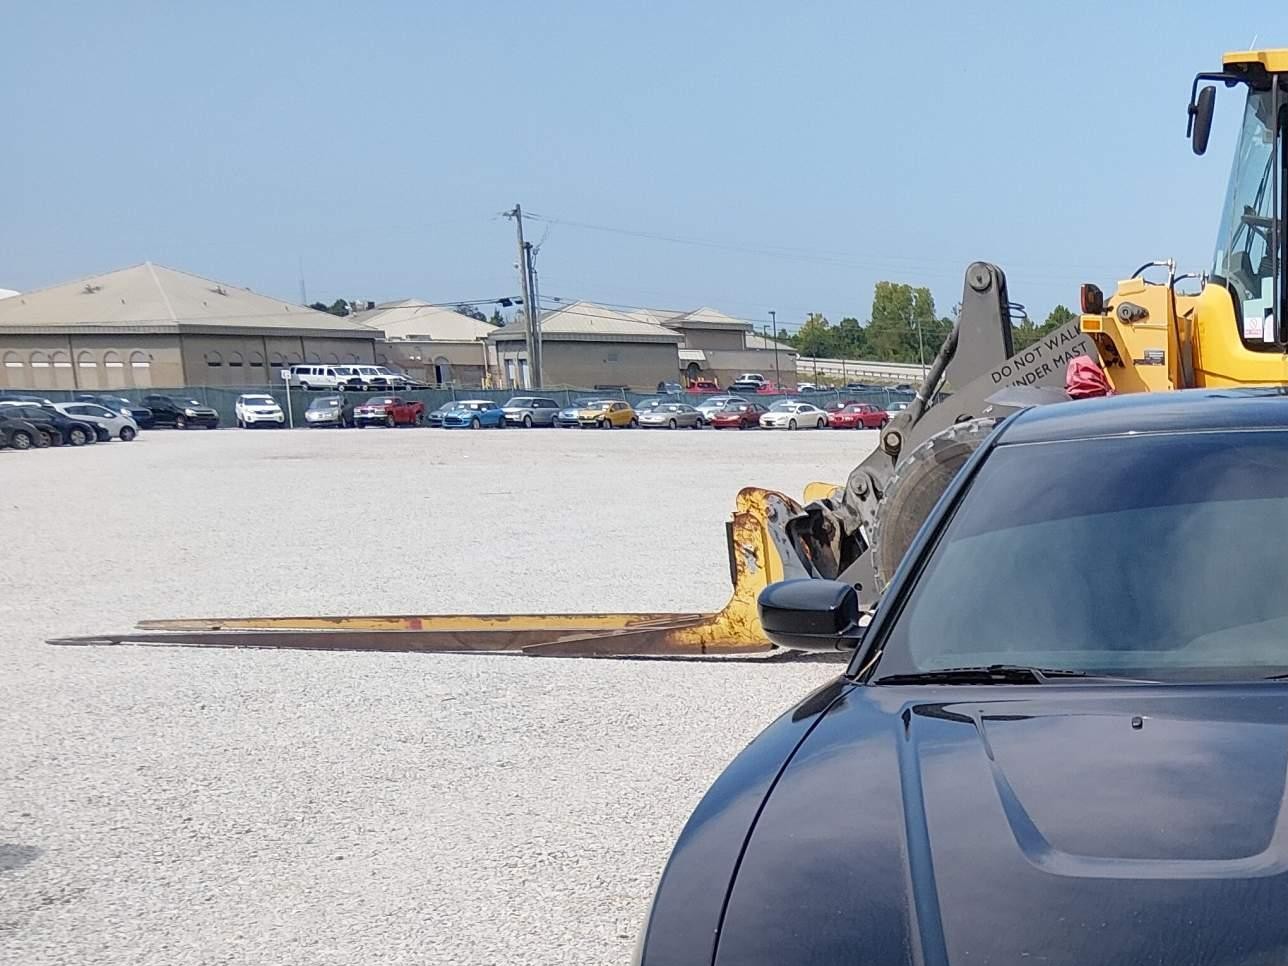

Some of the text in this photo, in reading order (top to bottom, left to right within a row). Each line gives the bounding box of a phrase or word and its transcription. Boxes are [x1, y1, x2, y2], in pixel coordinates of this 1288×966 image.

[991, 366, 1012, 384] DO
[1013, 346, 1043, 370] NOT
[1006, 341, 1087, 387] NDER MAST
